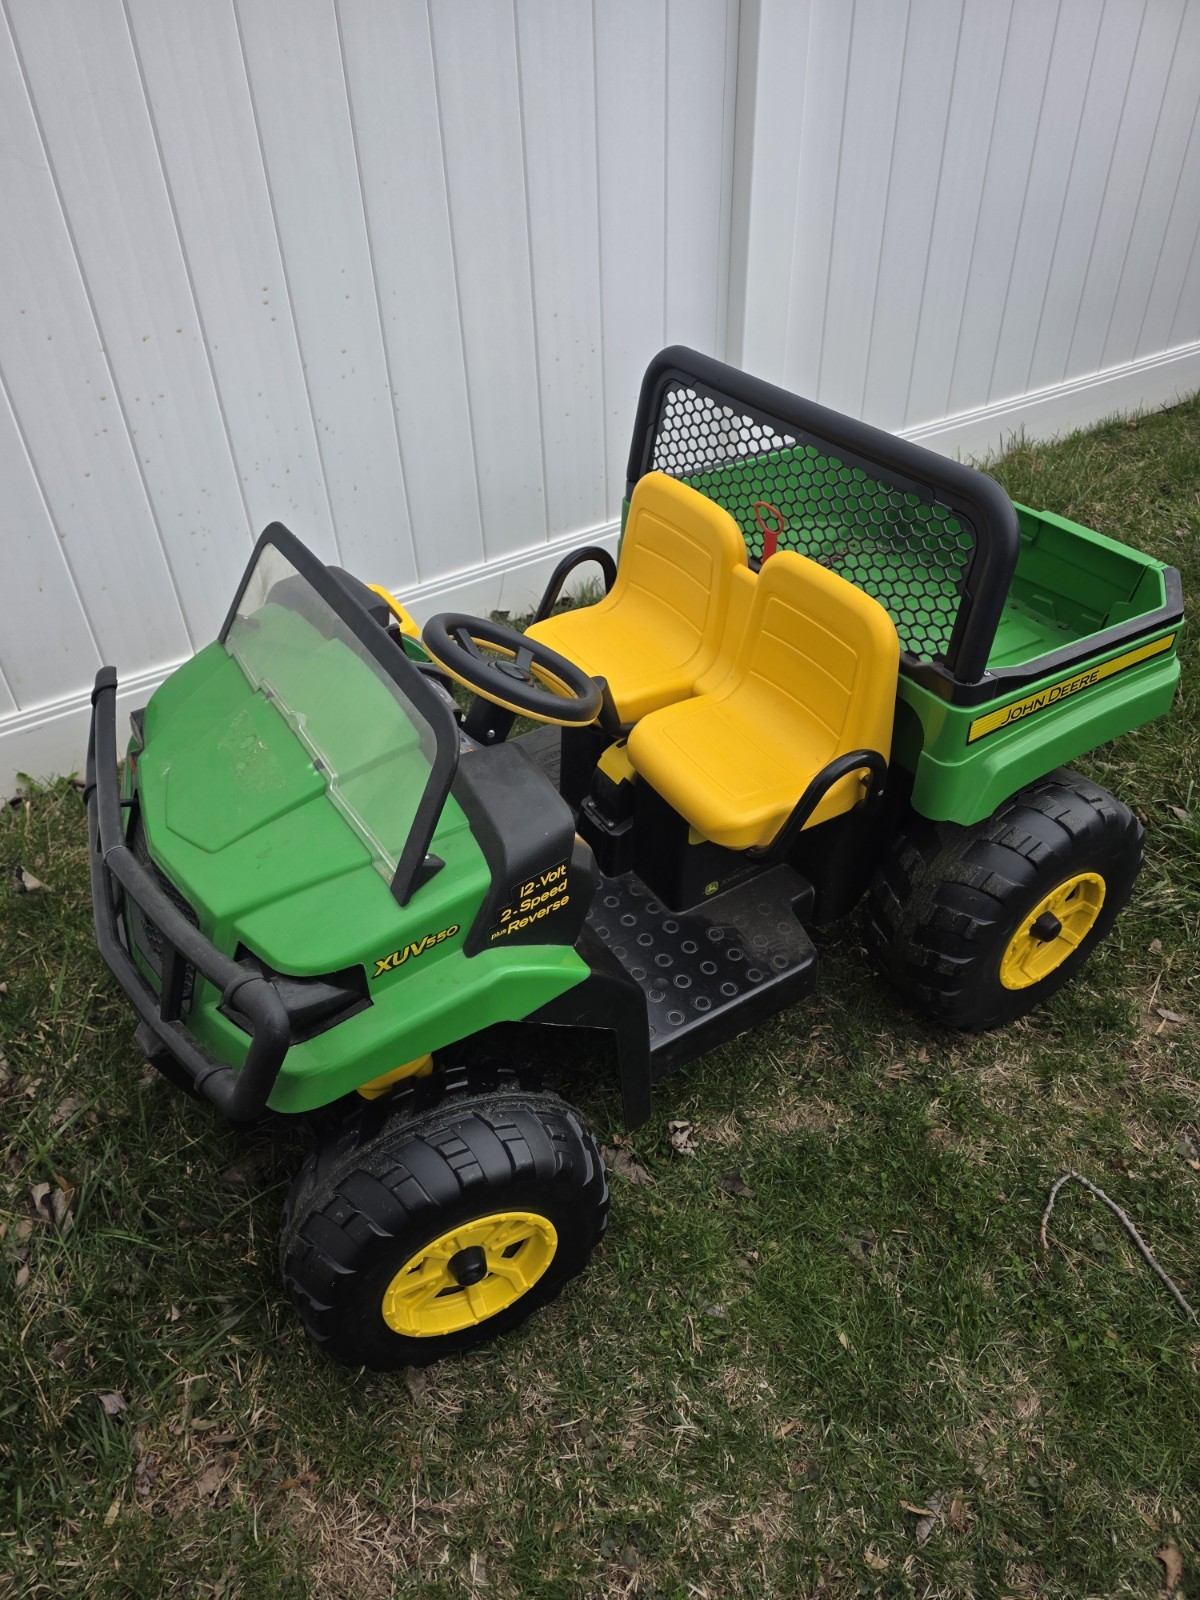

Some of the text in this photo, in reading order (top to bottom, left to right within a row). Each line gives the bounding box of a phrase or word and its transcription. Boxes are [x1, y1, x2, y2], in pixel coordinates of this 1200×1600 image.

[1002, 670, 1100, 725] JOHN DEERE
[500, 878, 568, 923] 2-Speed
[520, 864, 567, 898] 12-Volt
[490, 895, 570, 941] plus Reverse
[372, 924, 460, 979] XUV550
